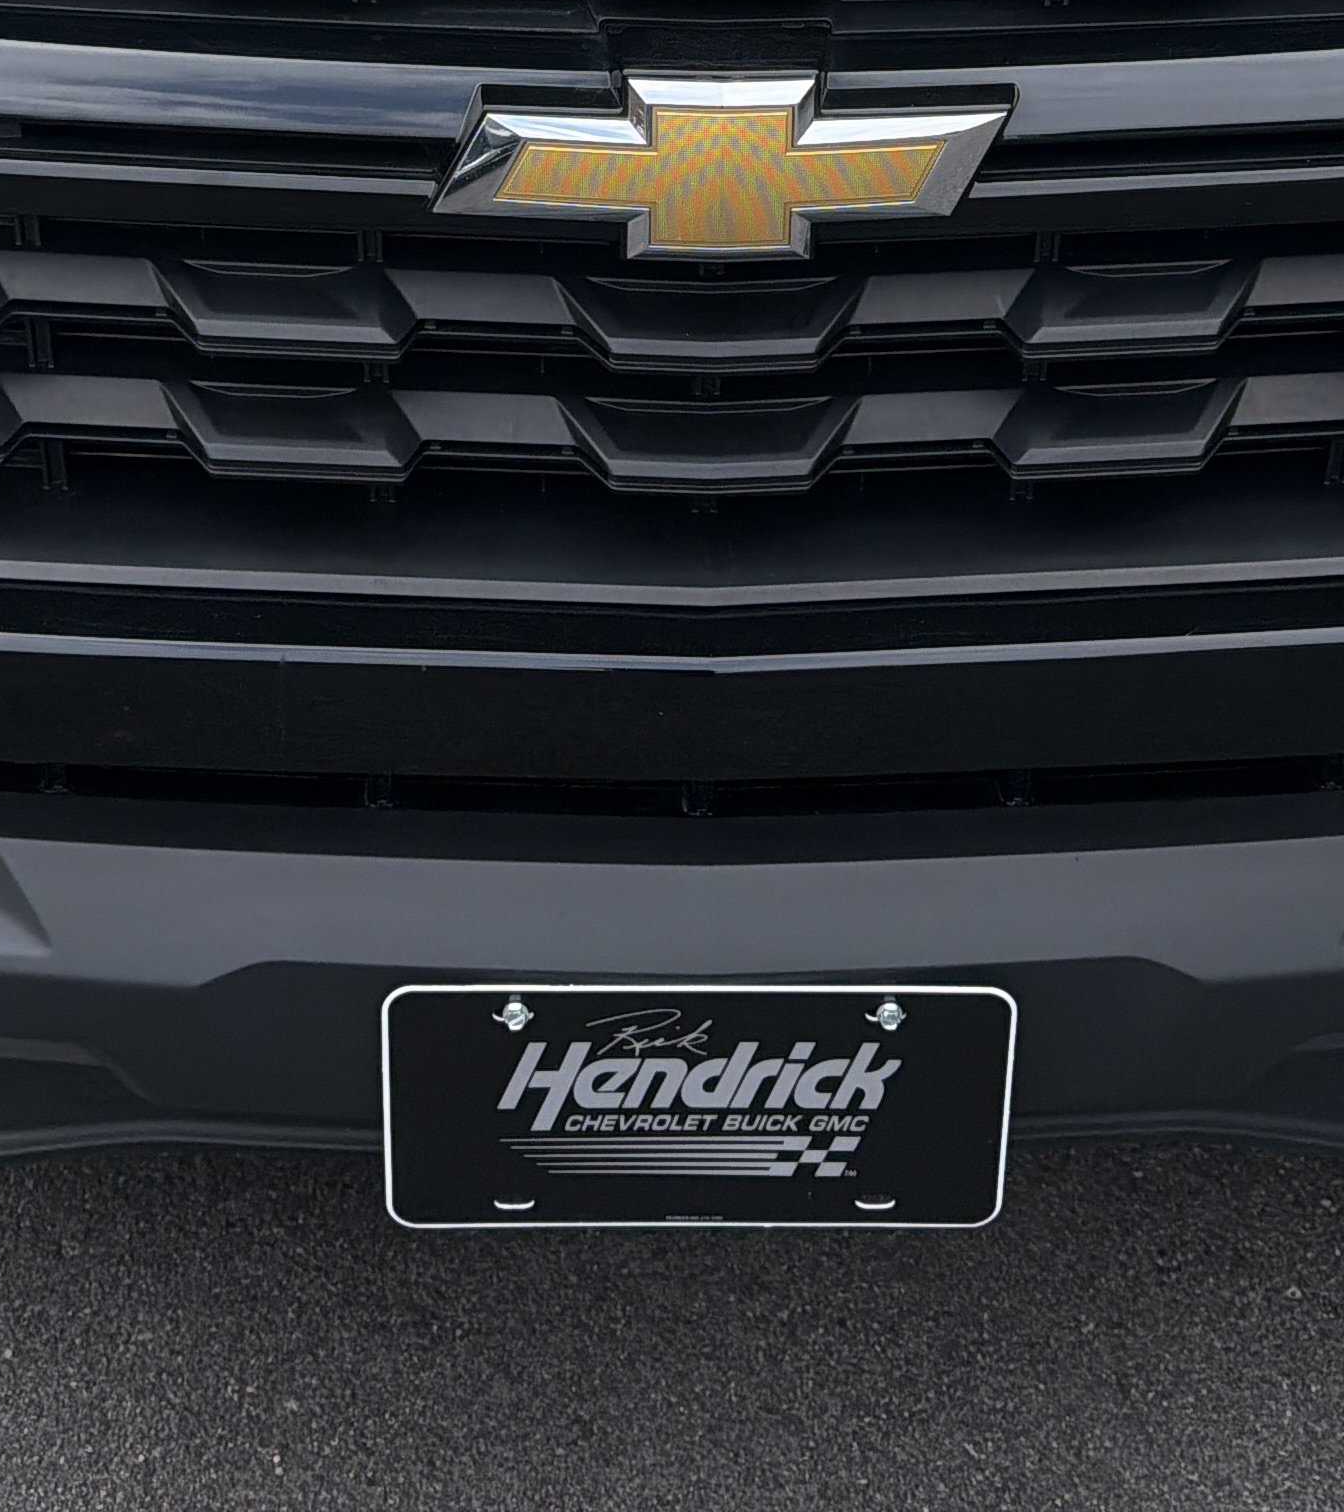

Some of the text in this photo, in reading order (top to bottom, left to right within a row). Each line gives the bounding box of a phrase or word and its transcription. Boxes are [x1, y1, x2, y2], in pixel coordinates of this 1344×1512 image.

[496, 1041, 903, 1132] Hendrick
[564, 1114, 870, 1133] CHEVROLET BUICK GMC
